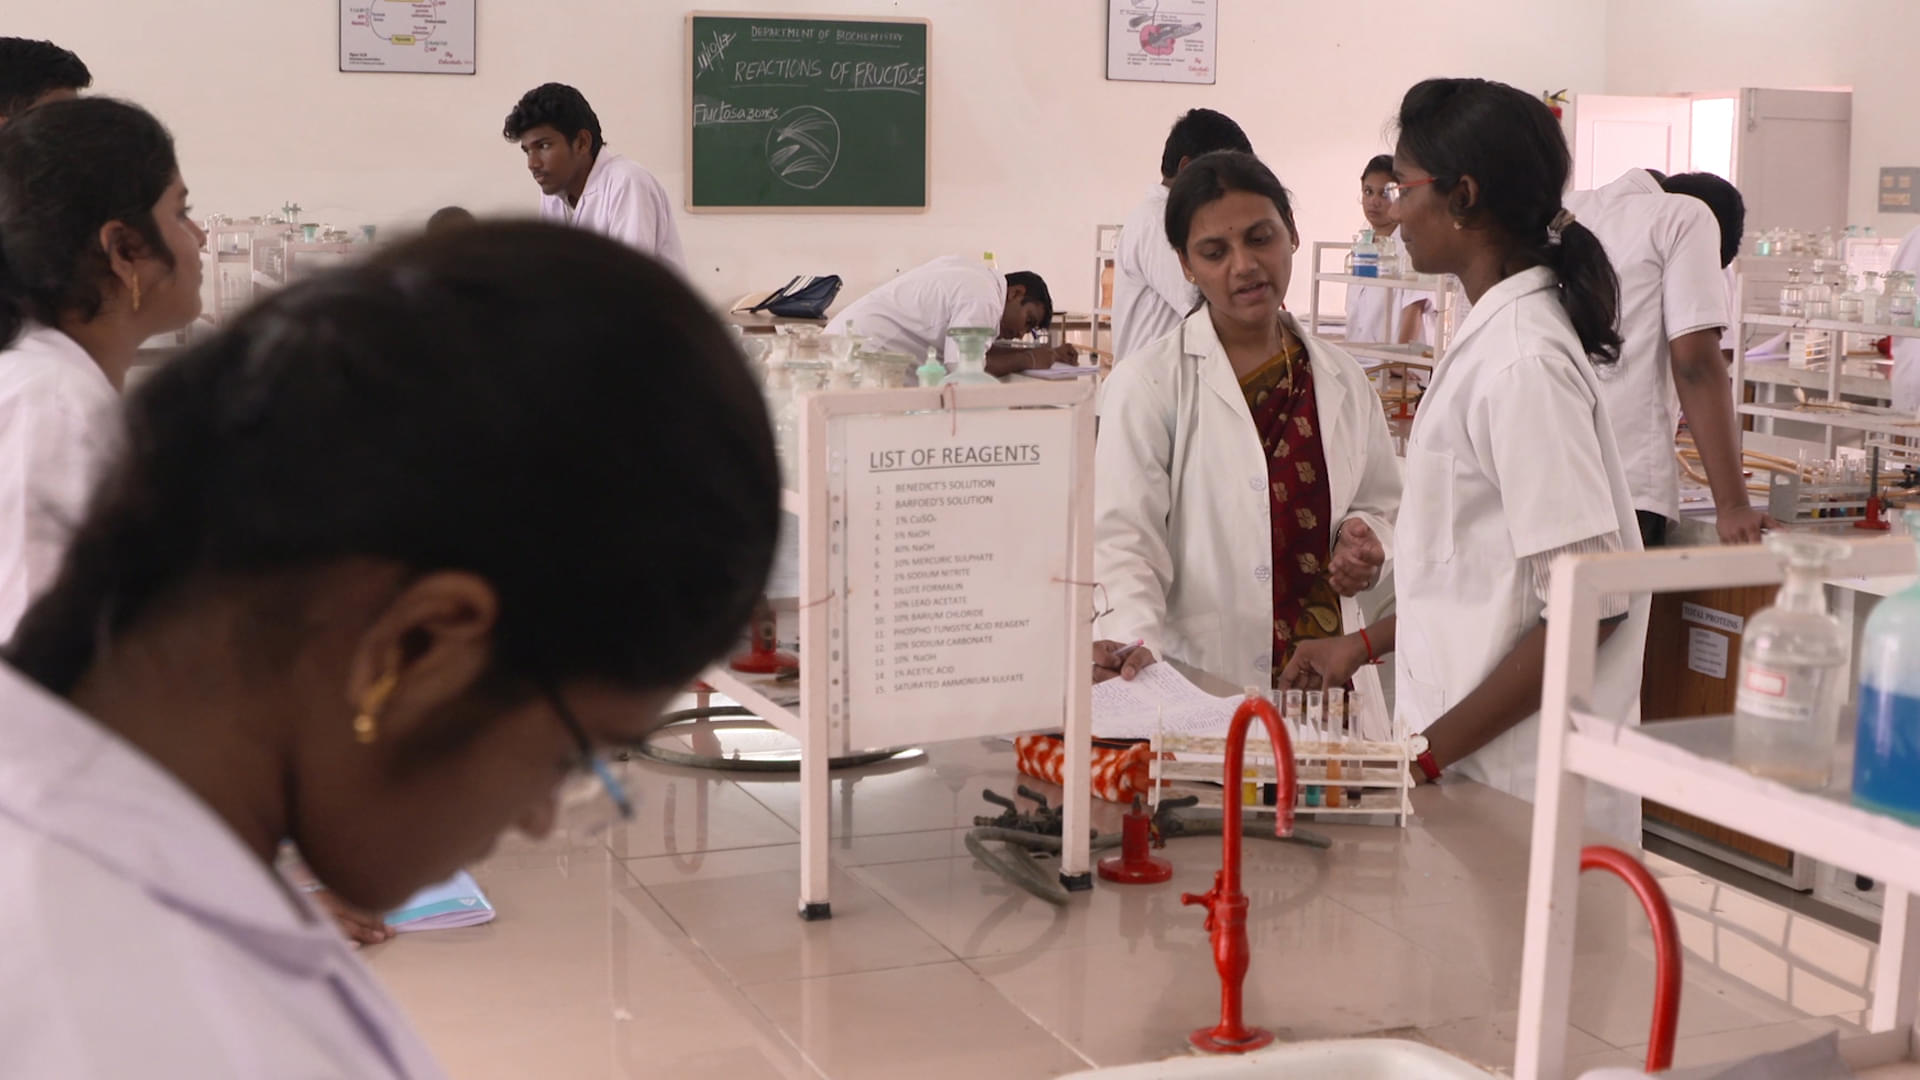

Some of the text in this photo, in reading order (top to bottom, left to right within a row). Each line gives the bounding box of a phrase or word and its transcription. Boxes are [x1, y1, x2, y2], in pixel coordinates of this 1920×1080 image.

[751, 25, 904, 41] DEPARTMENT OF BIOCHEMISTRY
[734, 58, 925, 89] REACTIONS OF FRUCTOSE
[869, 444, 1041, 469] LIST OF REAGENTS
[895, 481, 947, 493] BENEDICT'S
[948, 479, 996, 490] SOLUTION
[895, 497, 945, 509] BARFOED'S
[946, 495, 993, 506] SOLUTION
[907, 530, 931, 539] NaOH
[912, 543, 935, 552] NaOH
[911, 555, 953, 566] MERCURIC
[954, 553, 993, 563] SULPHATE
[906, 569, 939, 580] SODIUM
[941, 568, 970, 577] NITRITE
[893, 585, 920, 595] DILUTE
[921, 582, 964, 593] FORMALIN
[911, 598, 931, 608] LEAD
[933, 596, 967, 607] ACETATE
[911, 612, 943, 622] BARIUM
[945, 609, 984, 619] CHLORIDE
[893, 626, 931, 637] PHOSPHO
[973, 621, 993, 632] ACID
[994, 619, 1030, 630] REAGENT
[911, 639, 945, 649] SODIUM
[946, 636, 993, 647] CARBONATE
[913, 653, 937, 663] NaOH
[906, 667, 934, 677] ACETIC
[936, 665, 955, 675] ACID
[894, 680, 940, 692] SATURATED
[941, 676, 990, 688] AMMONIUM
